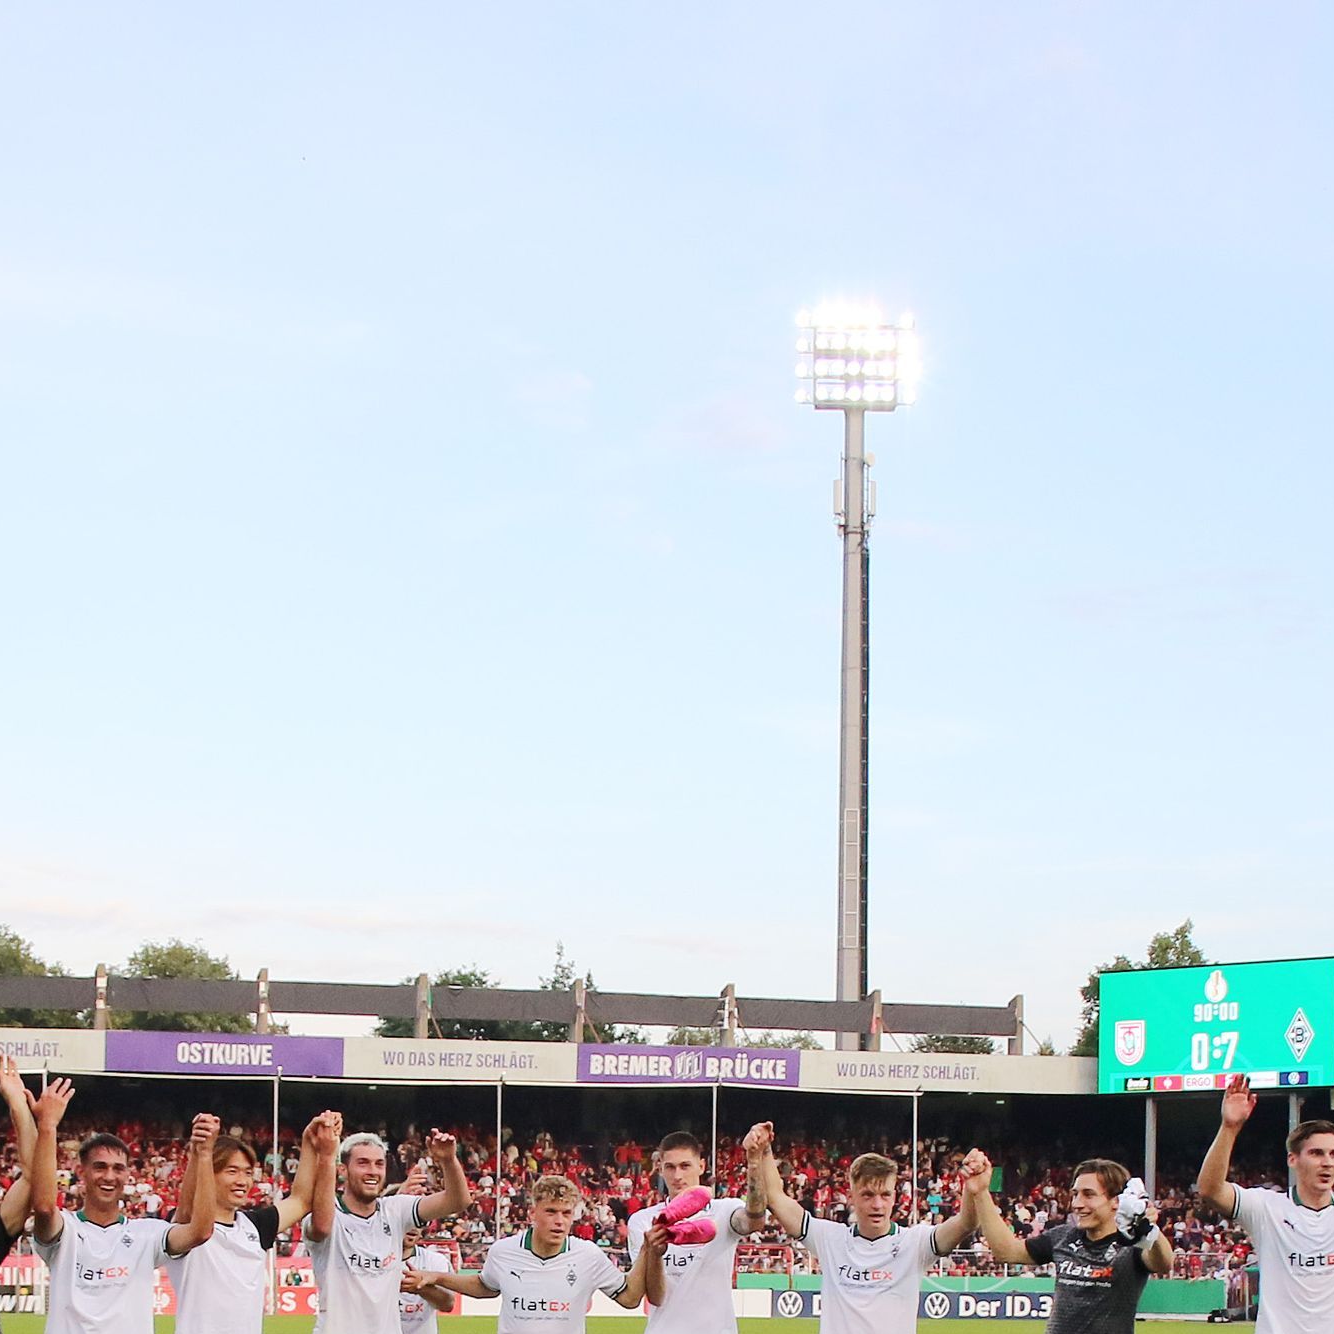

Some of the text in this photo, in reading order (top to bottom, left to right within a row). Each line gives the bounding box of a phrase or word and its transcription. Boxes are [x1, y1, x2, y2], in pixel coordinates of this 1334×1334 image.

[1194, 1001, 1239, 1023] 90:00
[176, 1041, 273, 1066] OSTKURVE
[383, 1050, 538, 1069] WO DAS HERZ SCHLÄGT.
[1190, 1031, 1239, 1071] 0:7
[589, 1053, 672, 1077] BREMER
[705, 1053, 786, 1080] BRÜCKE
[837, 1062, 980, 1080] WO DAS HERZ SCHLÄGT.
[1186, 1077, 1211, 1087] ERGO
[959, 1295, 1001, 1317] Der
[1005, 1295, 1053, 1317] ID.3
